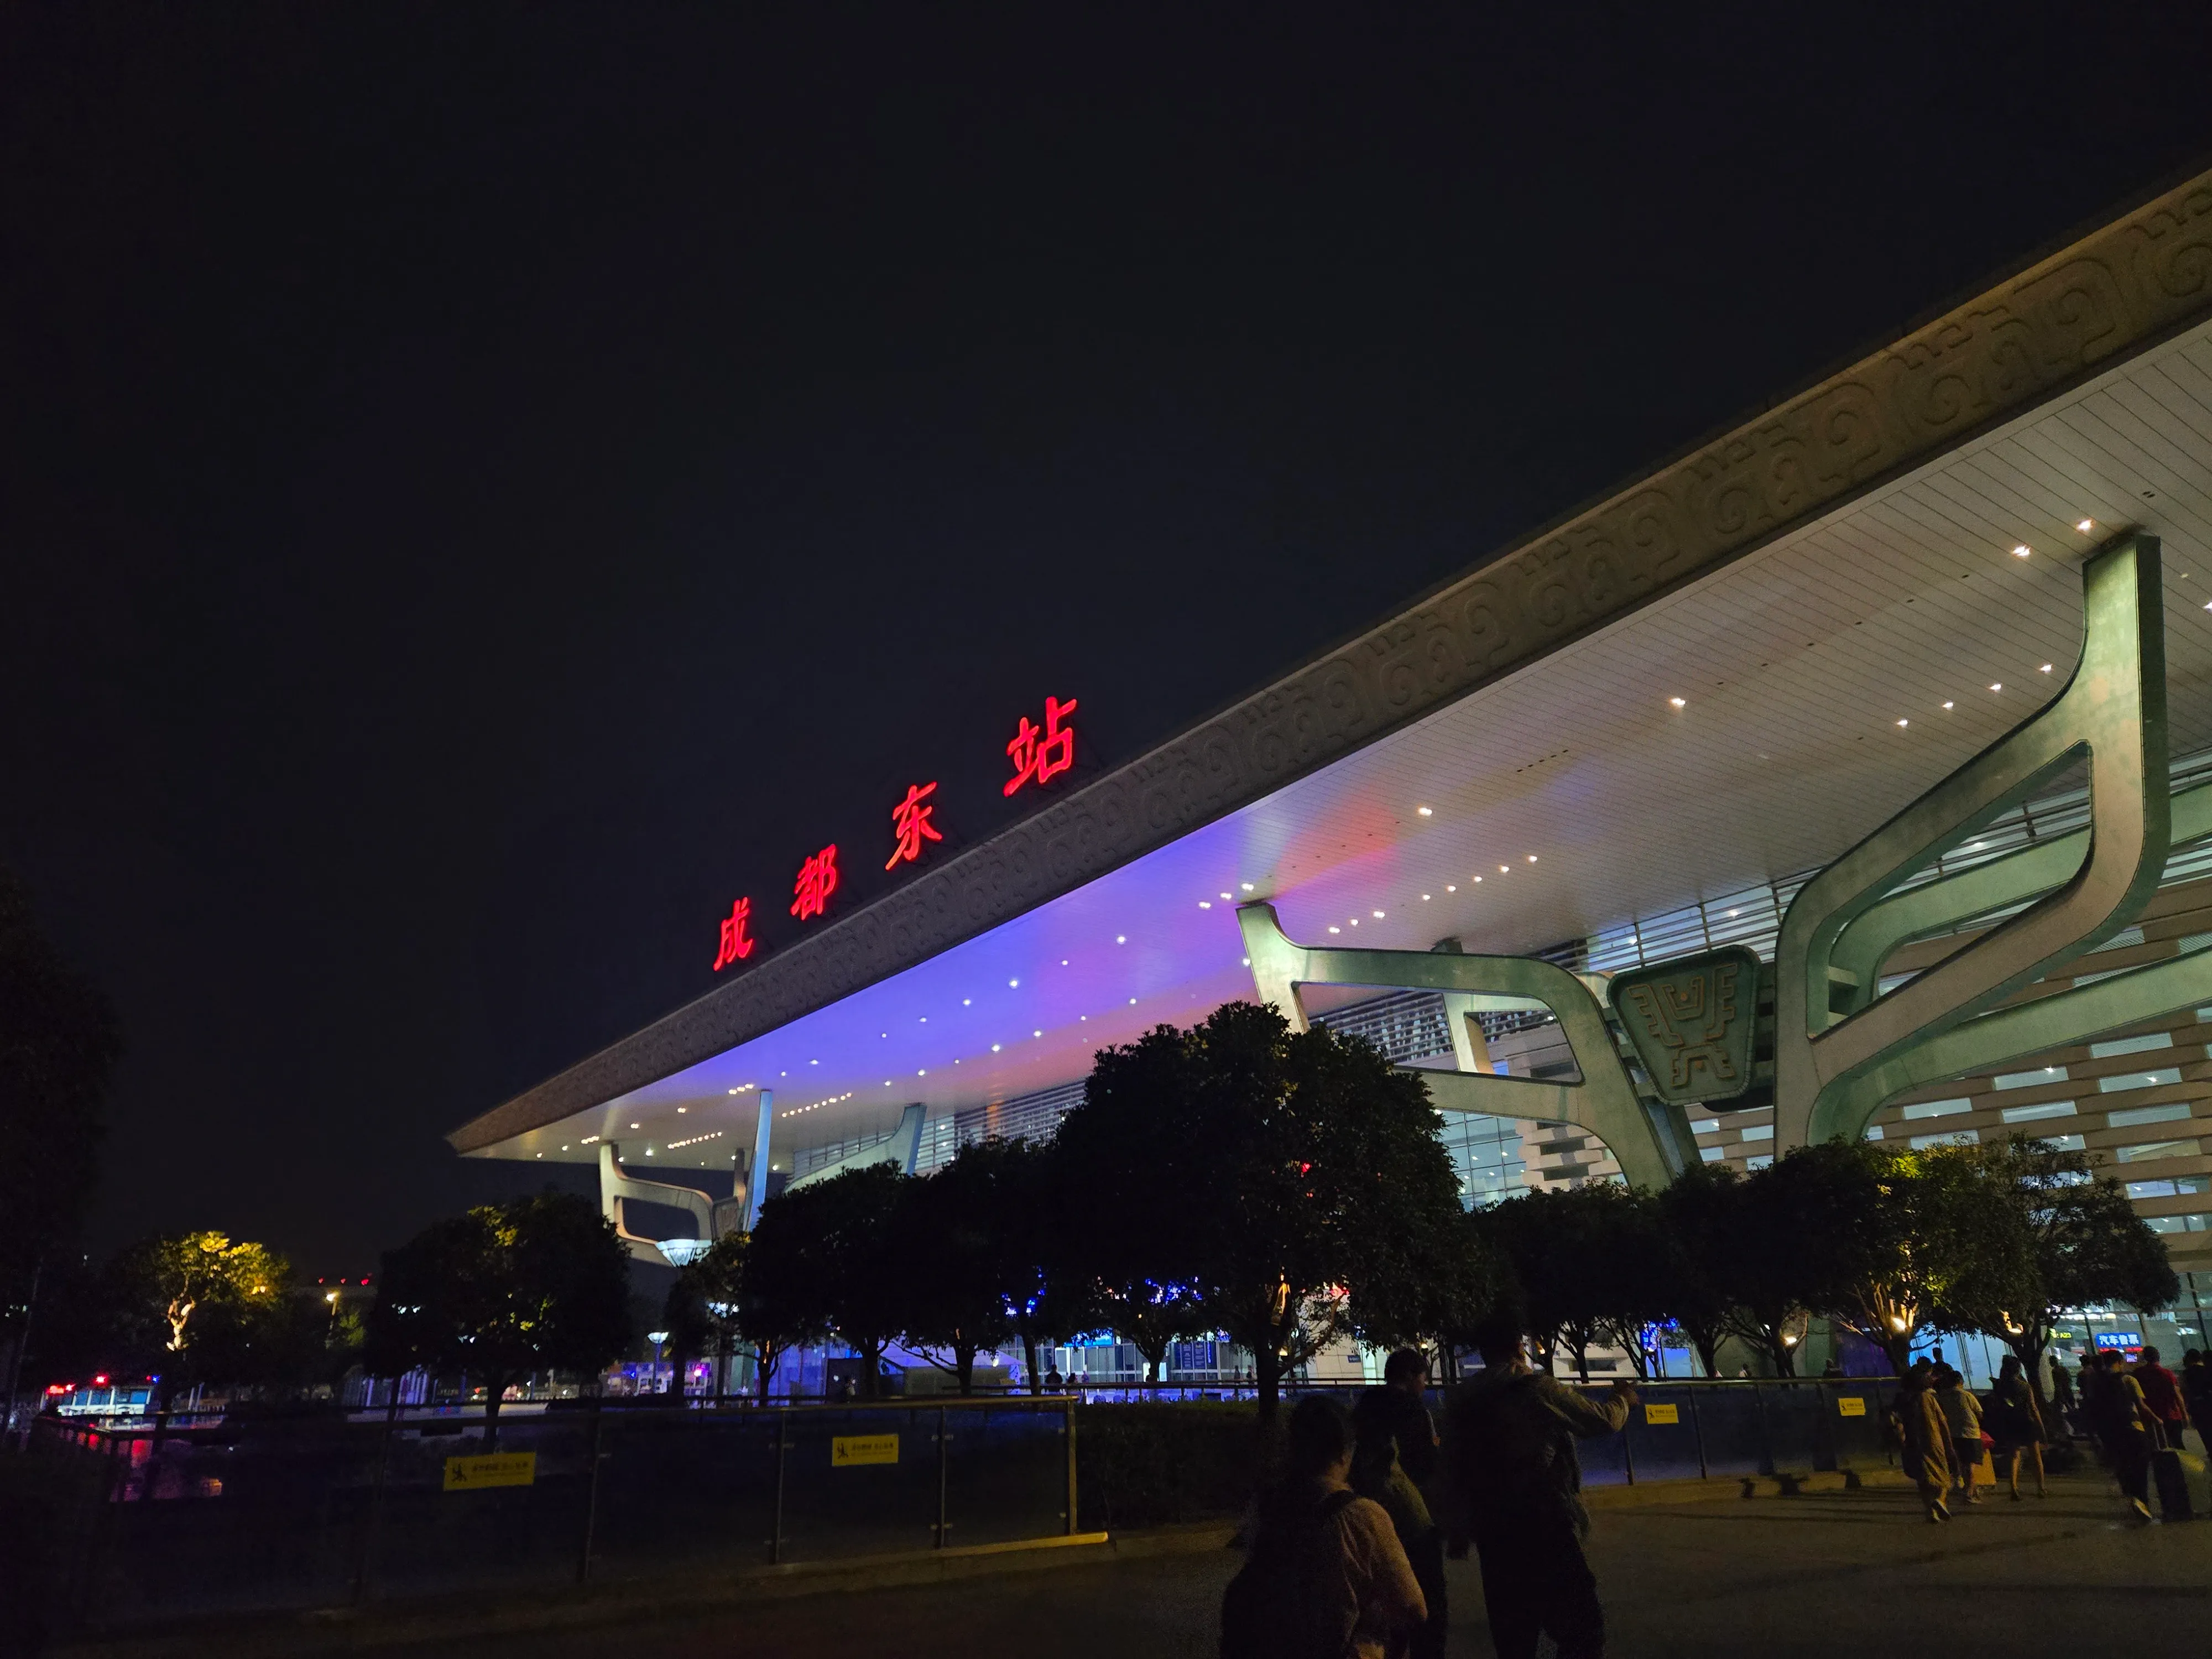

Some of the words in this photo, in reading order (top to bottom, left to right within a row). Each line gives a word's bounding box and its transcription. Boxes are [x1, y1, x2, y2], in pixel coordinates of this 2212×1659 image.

[712, 696, 1078, 972] 成都东站
[2099, 1334, 2140, 1345] 汽车售票
